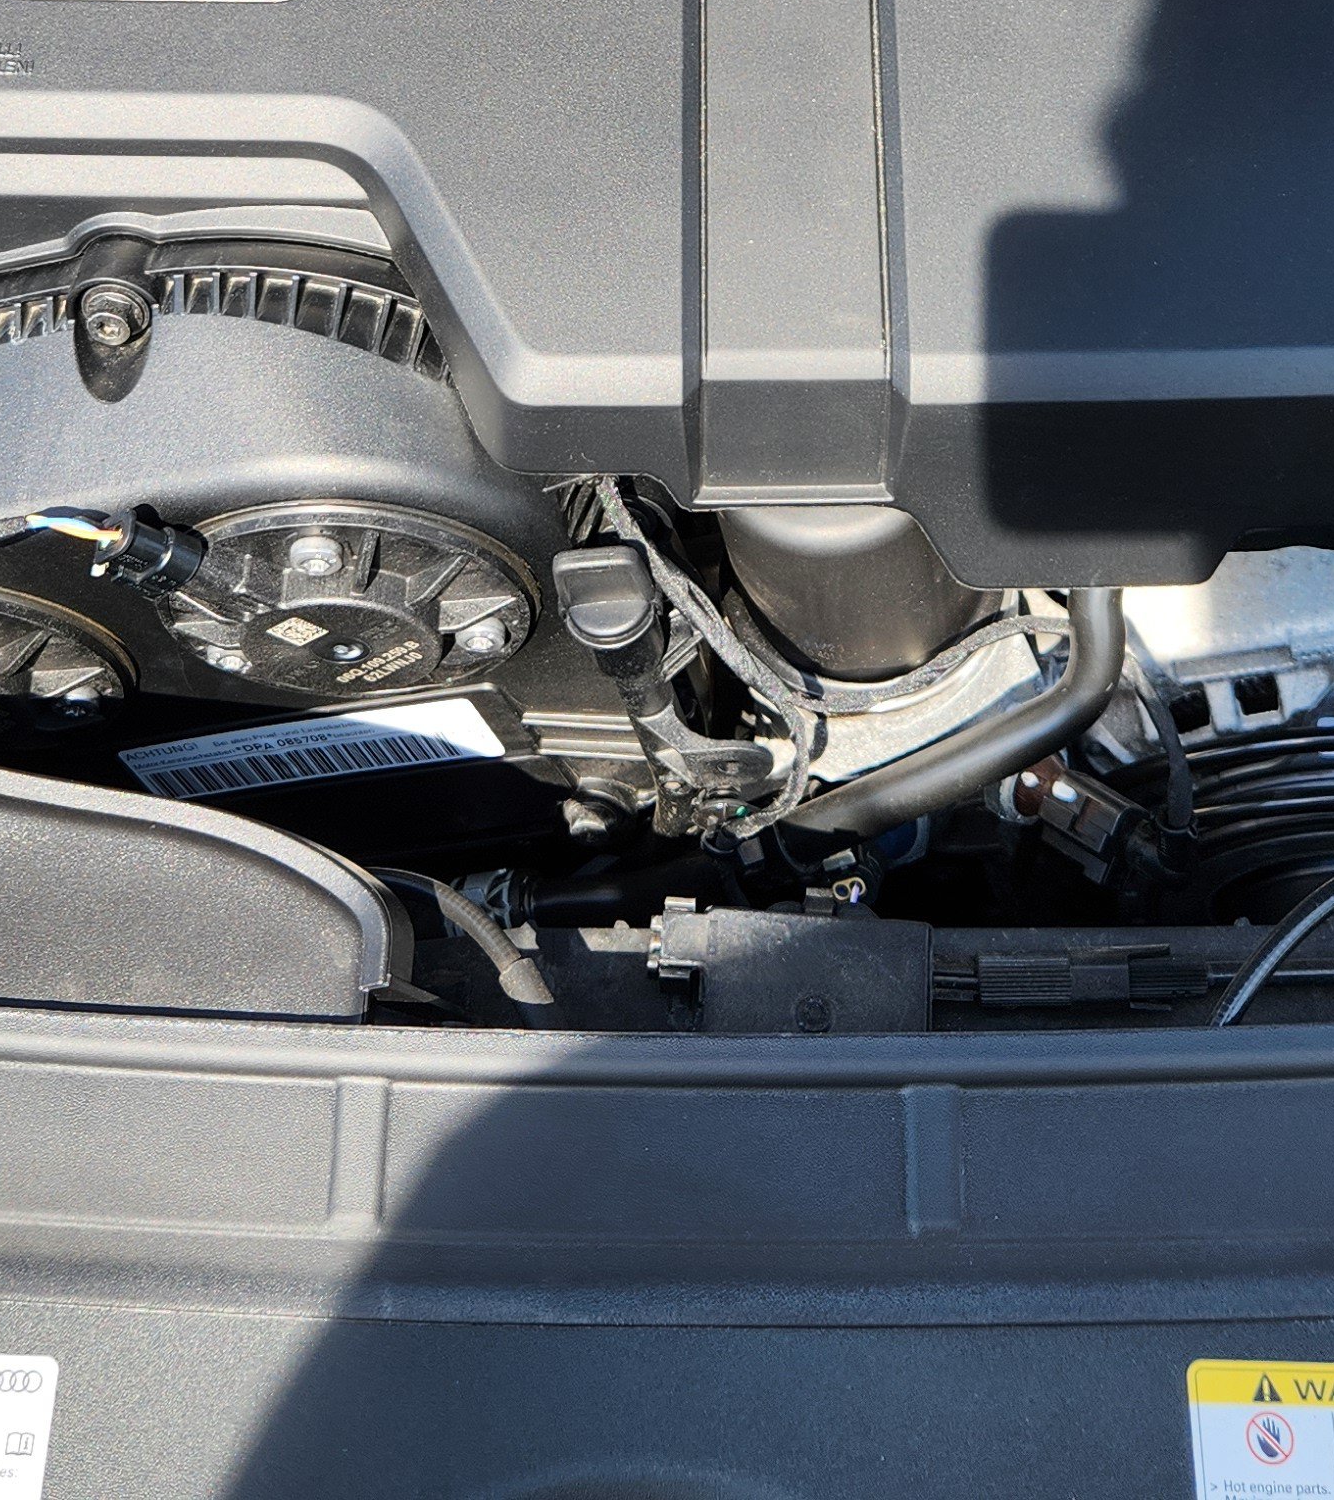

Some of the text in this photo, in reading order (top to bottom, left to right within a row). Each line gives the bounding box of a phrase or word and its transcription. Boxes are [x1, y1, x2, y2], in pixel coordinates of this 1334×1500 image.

[1223, 1480, 1331, 1496] Hot engine parts.
